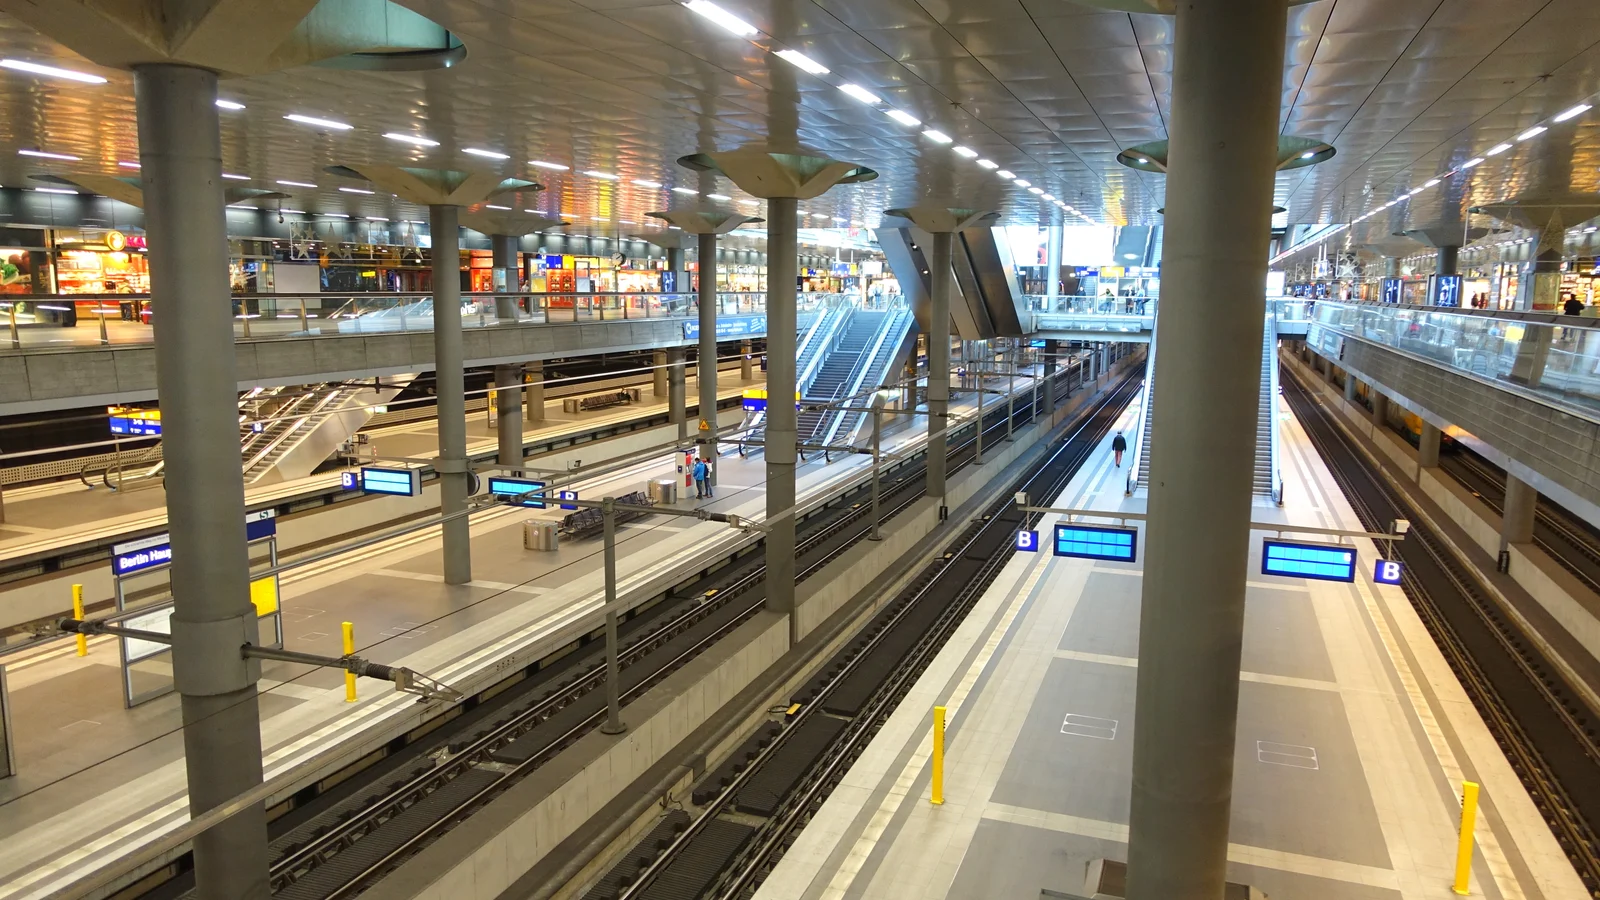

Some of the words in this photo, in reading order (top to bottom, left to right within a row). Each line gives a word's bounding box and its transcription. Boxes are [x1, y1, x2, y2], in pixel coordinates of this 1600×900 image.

[127, 236, 148, 247] KA
[343, 473, 352, 486] B
[1018, 530, 1032, 547] B
[1058, 529, 1065, 538] 5
[119, 553, 149, 570] Berlin
[1382, 561, 1400, 580] B
